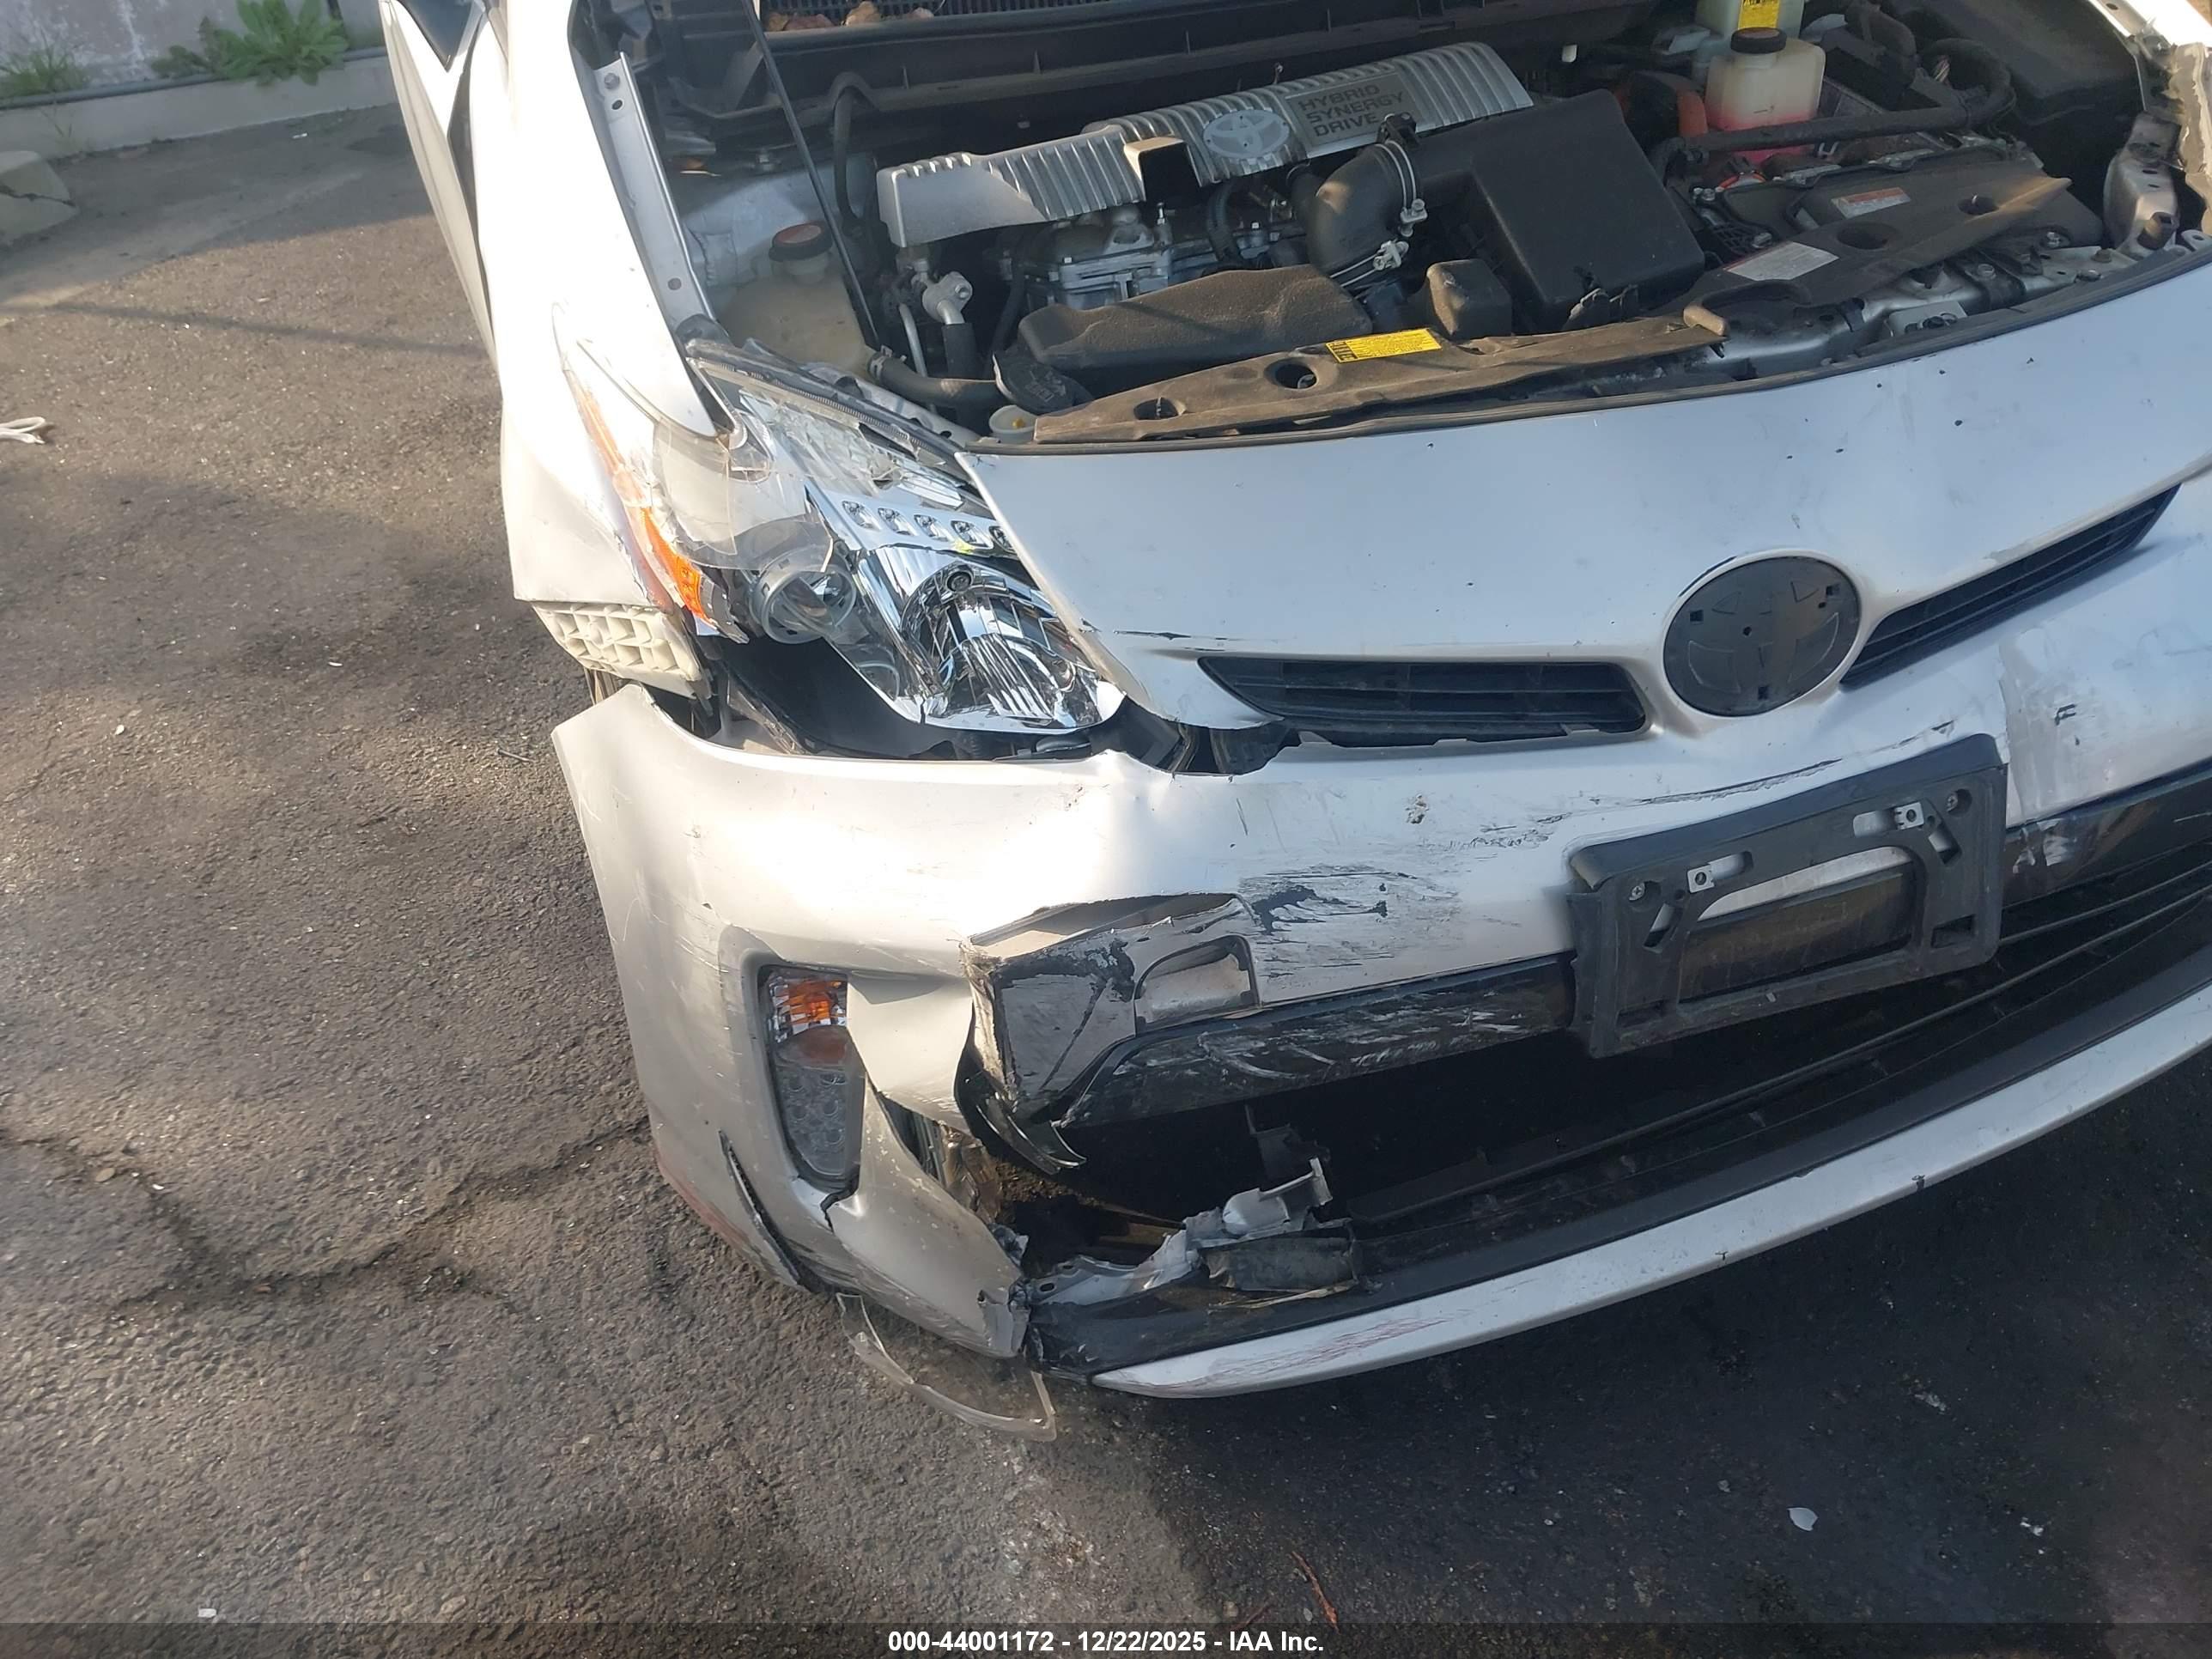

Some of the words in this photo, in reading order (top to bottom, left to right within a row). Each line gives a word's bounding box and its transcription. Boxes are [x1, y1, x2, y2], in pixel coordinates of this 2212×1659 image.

[1297, 84, 1380, 111] HYBRID
[1306, 91, 1403, 124] SYNERGY
[1313, 112, 1379, 137] DRIVE
